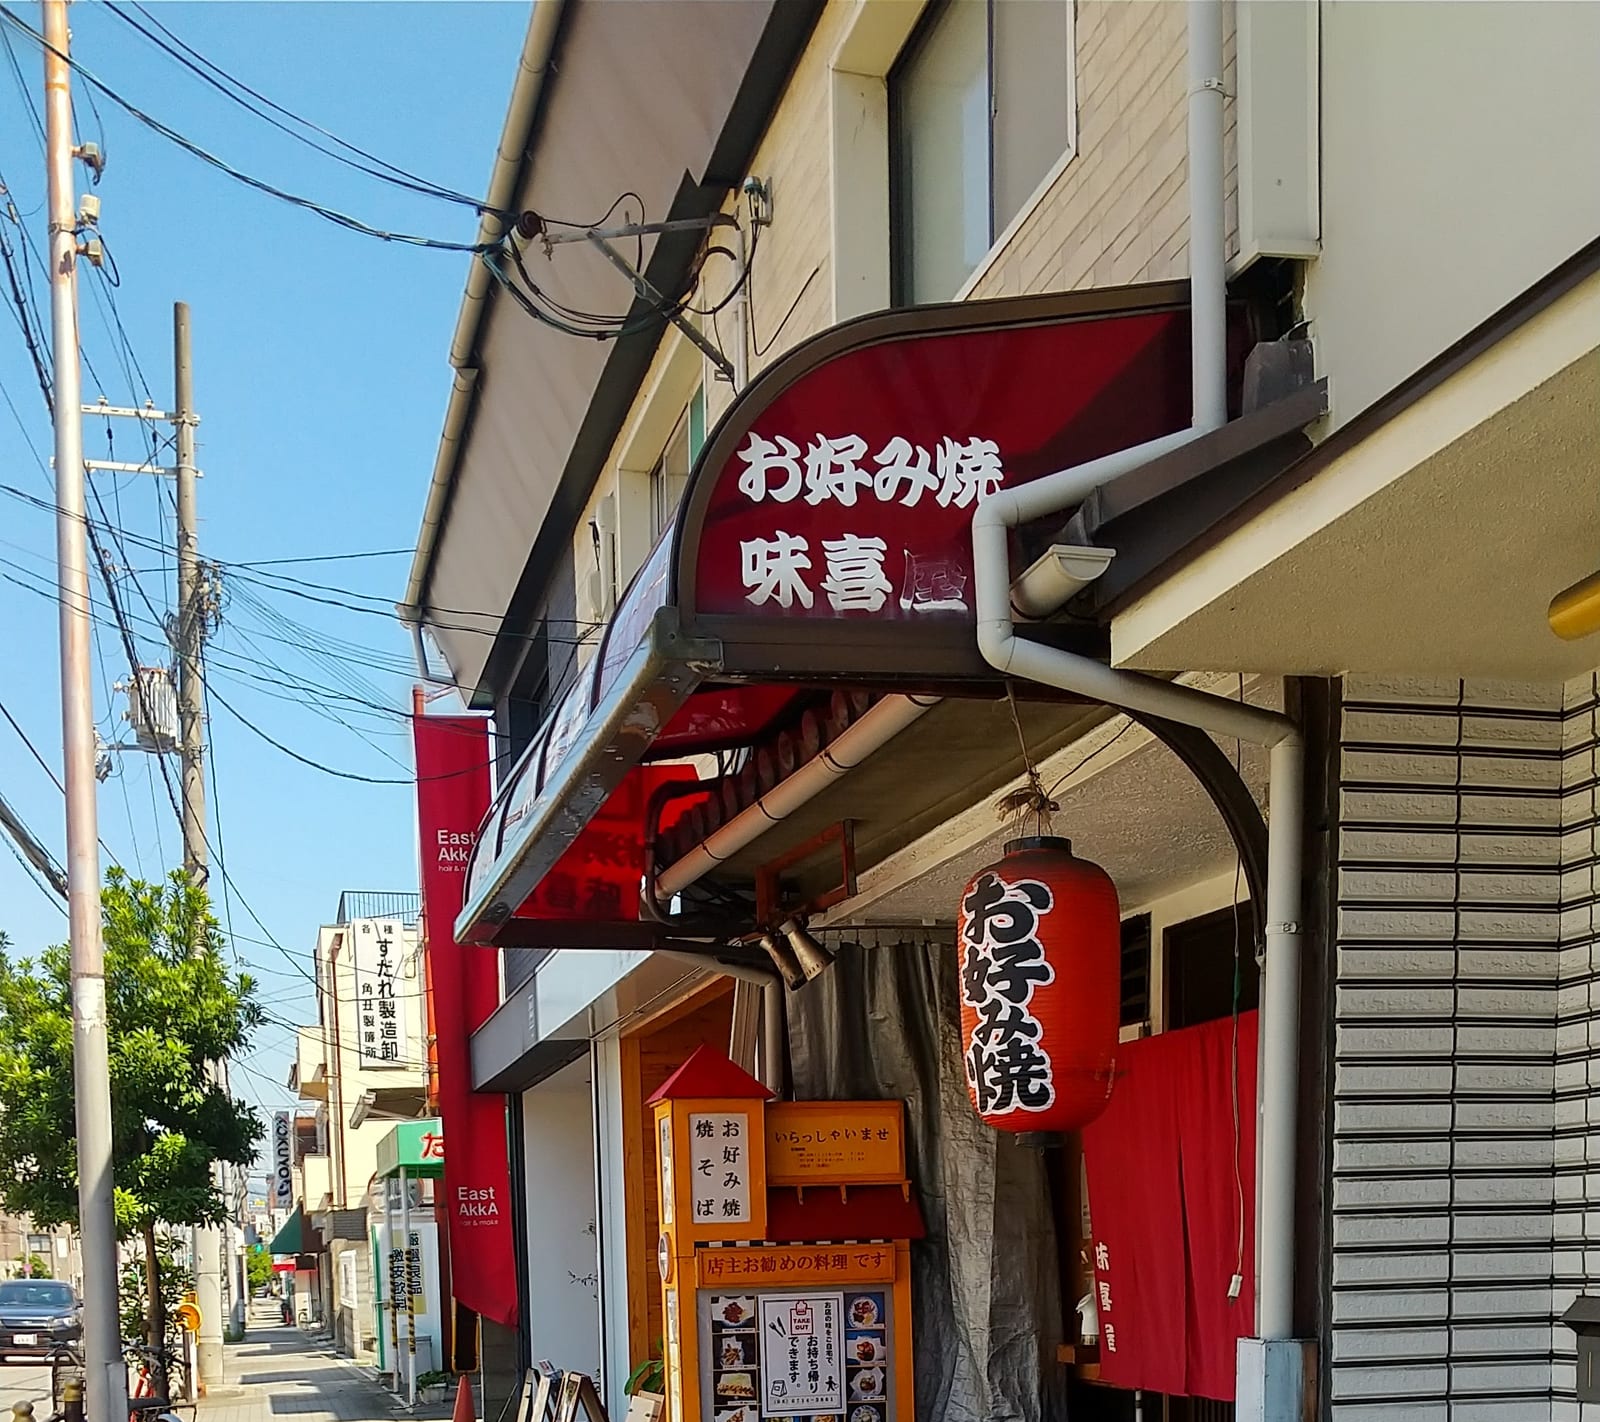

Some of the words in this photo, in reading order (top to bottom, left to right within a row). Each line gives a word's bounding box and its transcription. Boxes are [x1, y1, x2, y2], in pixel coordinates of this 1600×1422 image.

[736, 431, 1004, 508] お好み焼
[437, 829, 476, 845] East
[438, 846, 469, 861] Akk
[376, 938, 398, 1061] すだれ製造卸
[962, 871, 1055, 1114] お好み焼
[775, 1127, 890, 1143] いらっしゃいませ
[457, 1186, 495, 1200] East
[695, 1119, 715, 1217] 焼そば
[722, 1119, 741, 1217] お好み焼
[458, 1202, 499, 1216] AkkA
[788, 1336, 801, 1388] できます。
[807, 1336, 820, 1394] お持ち帰り
